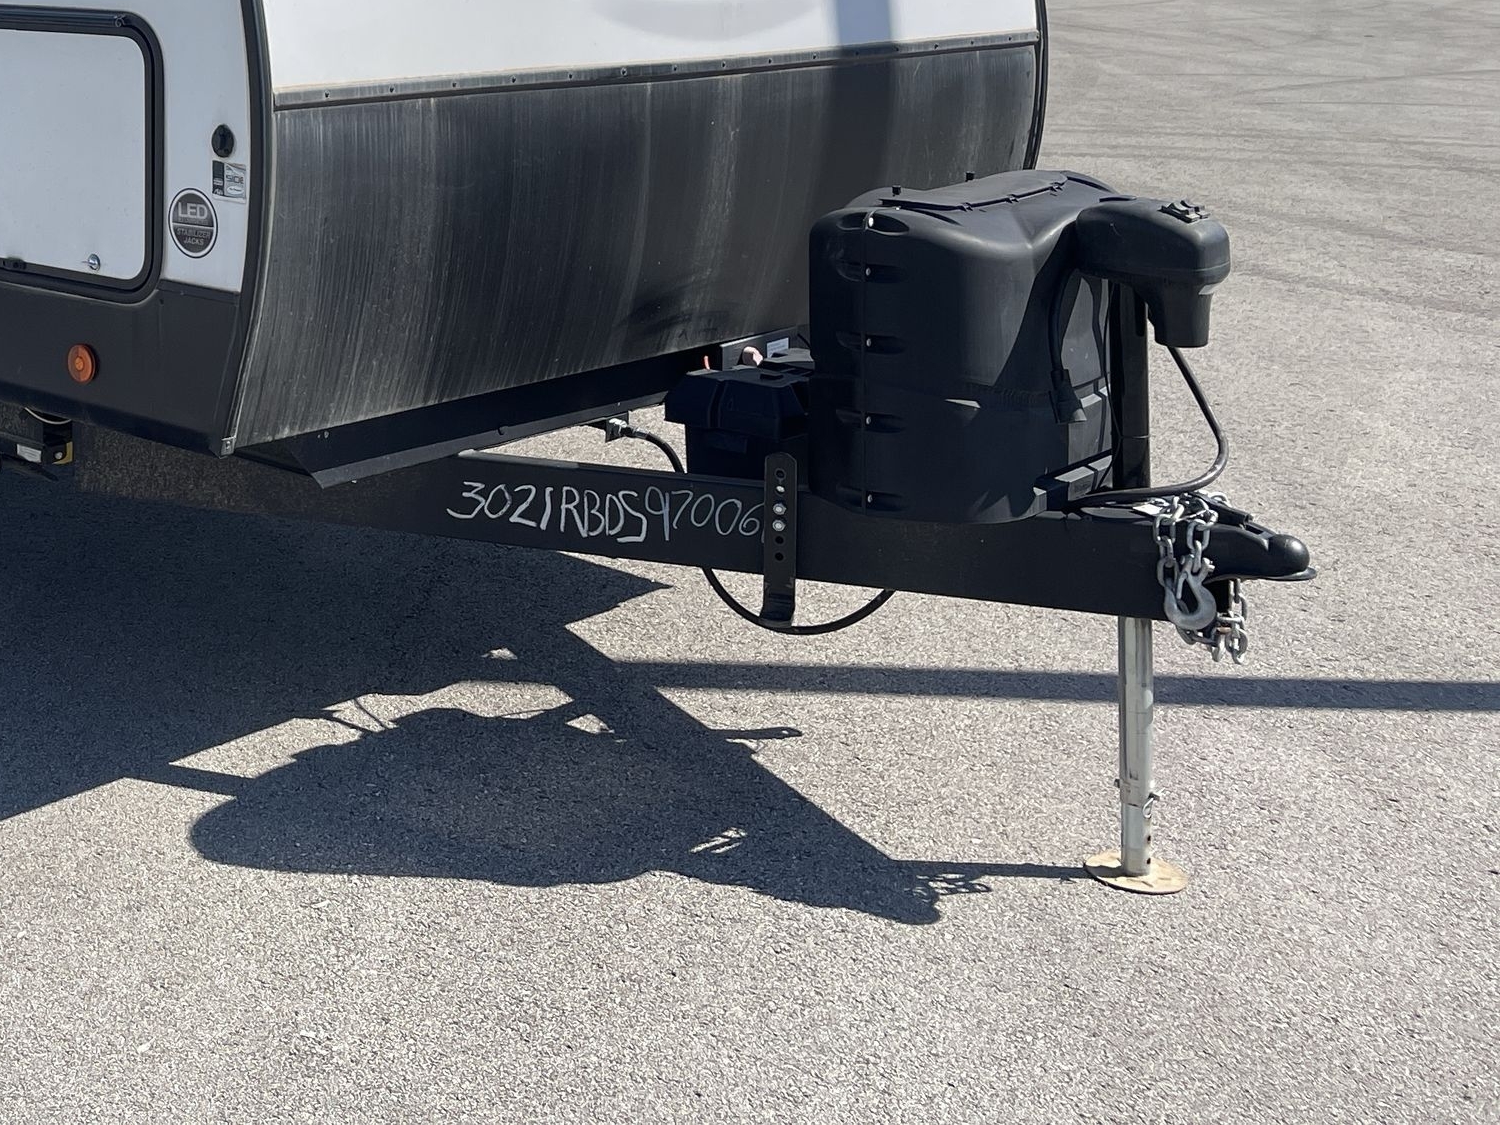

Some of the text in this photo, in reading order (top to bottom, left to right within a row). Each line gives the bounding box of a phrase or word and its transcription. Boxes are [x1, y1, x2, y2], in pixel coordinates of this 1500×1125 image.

[178, 202, 208, 219] LED
[184, 237, 204, 245] JACKS
[446, 480, 765, 543] 3021RBDS97006
